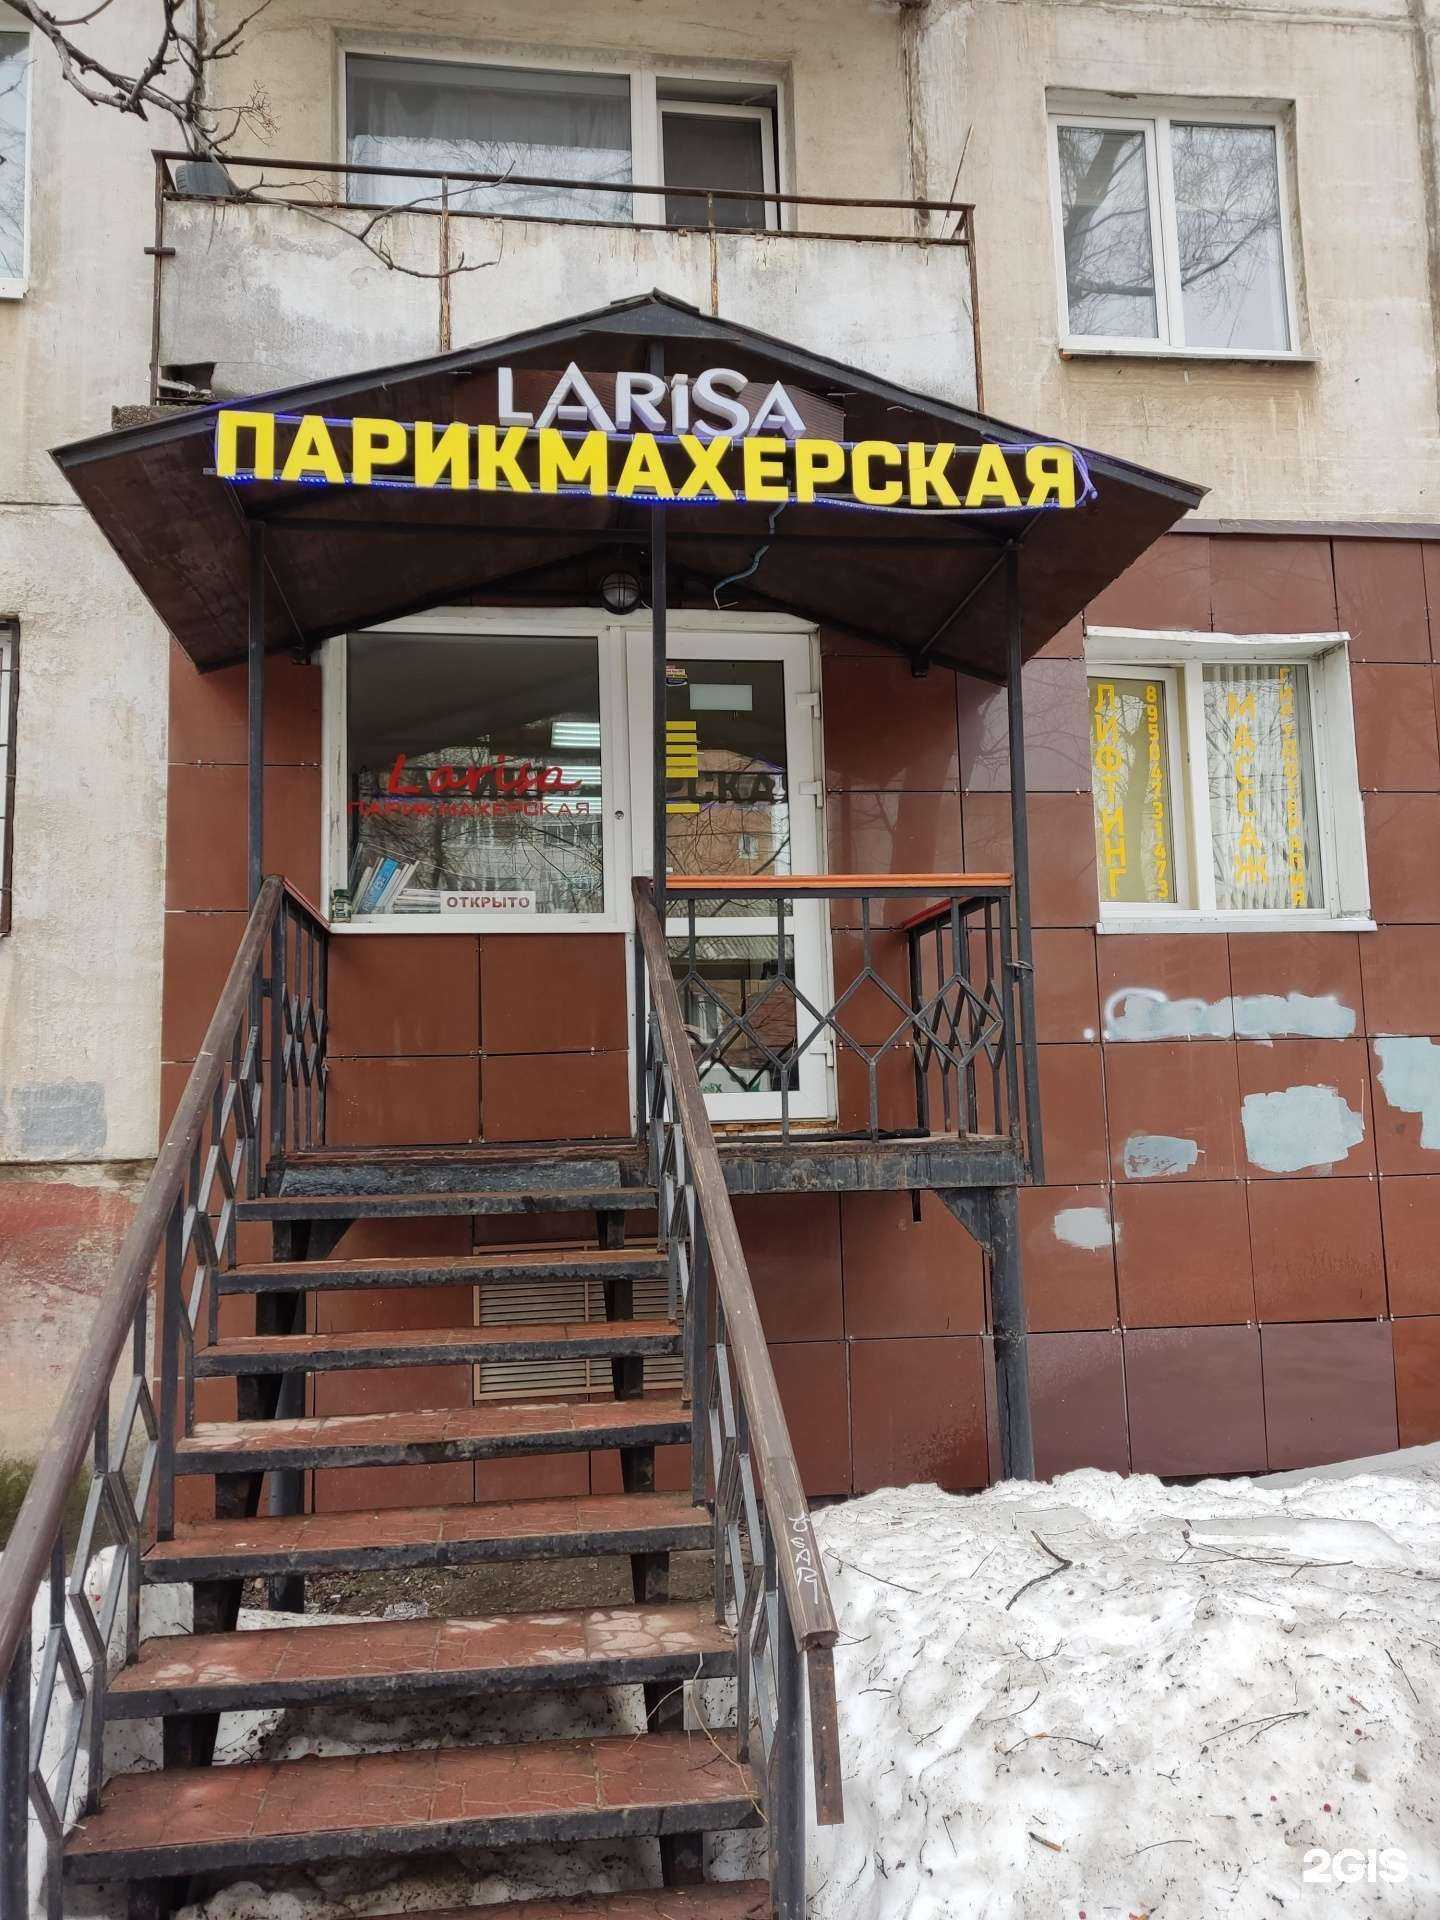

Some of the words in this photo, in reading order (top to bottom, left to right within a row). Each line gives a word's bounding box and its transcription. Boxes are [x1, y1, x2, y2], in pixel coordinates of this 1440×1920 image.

[217, 410, 1077, 509] ПАРИКМАХЕРСКАЯ
[387, 753, 582, 795] Larisa
[1095, 684, 1127, 897] ЛИФТИНГ
[1228, 690, 1269, 885] МАССАЖ
[347, 802, 590, 817] ПАРИКМАХЕРСКАЯ
[446, 896, 530, 908] ОТКРЫТО
